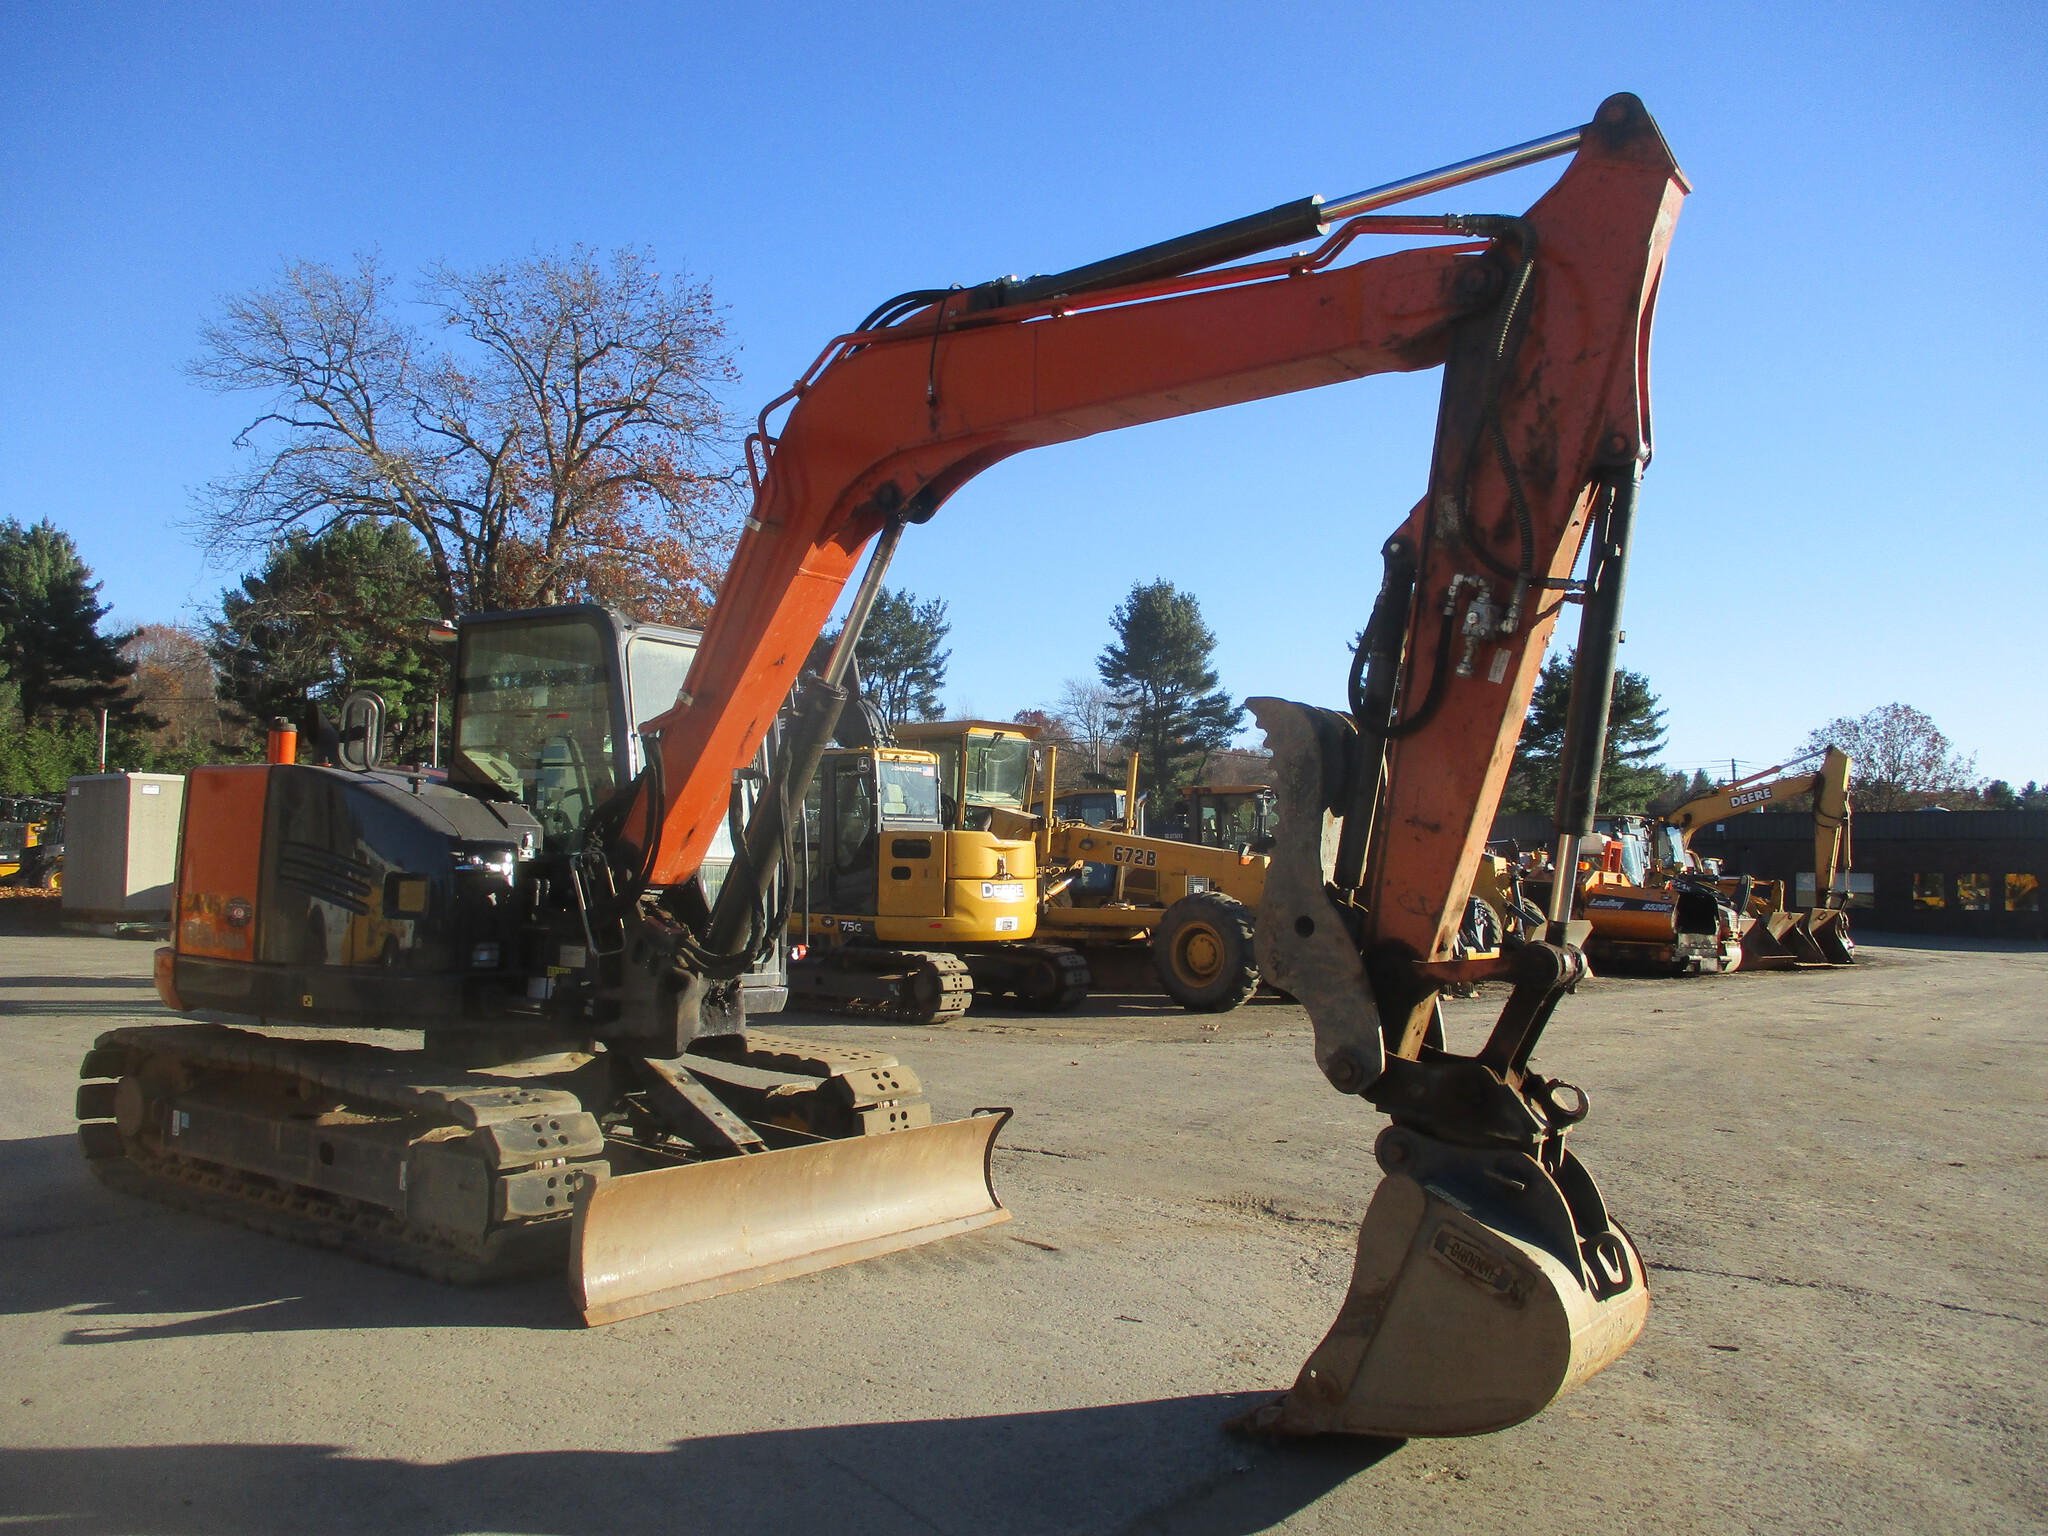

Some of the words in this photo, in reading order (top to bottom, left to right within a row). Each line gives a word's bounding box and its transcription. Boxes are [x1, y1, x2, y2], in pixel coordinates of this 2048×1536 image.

[1730, 787, 1772, 808] DEERE
[1113, 845, 1157, 867] 672B
[841, 921, 862, 933] 75G
